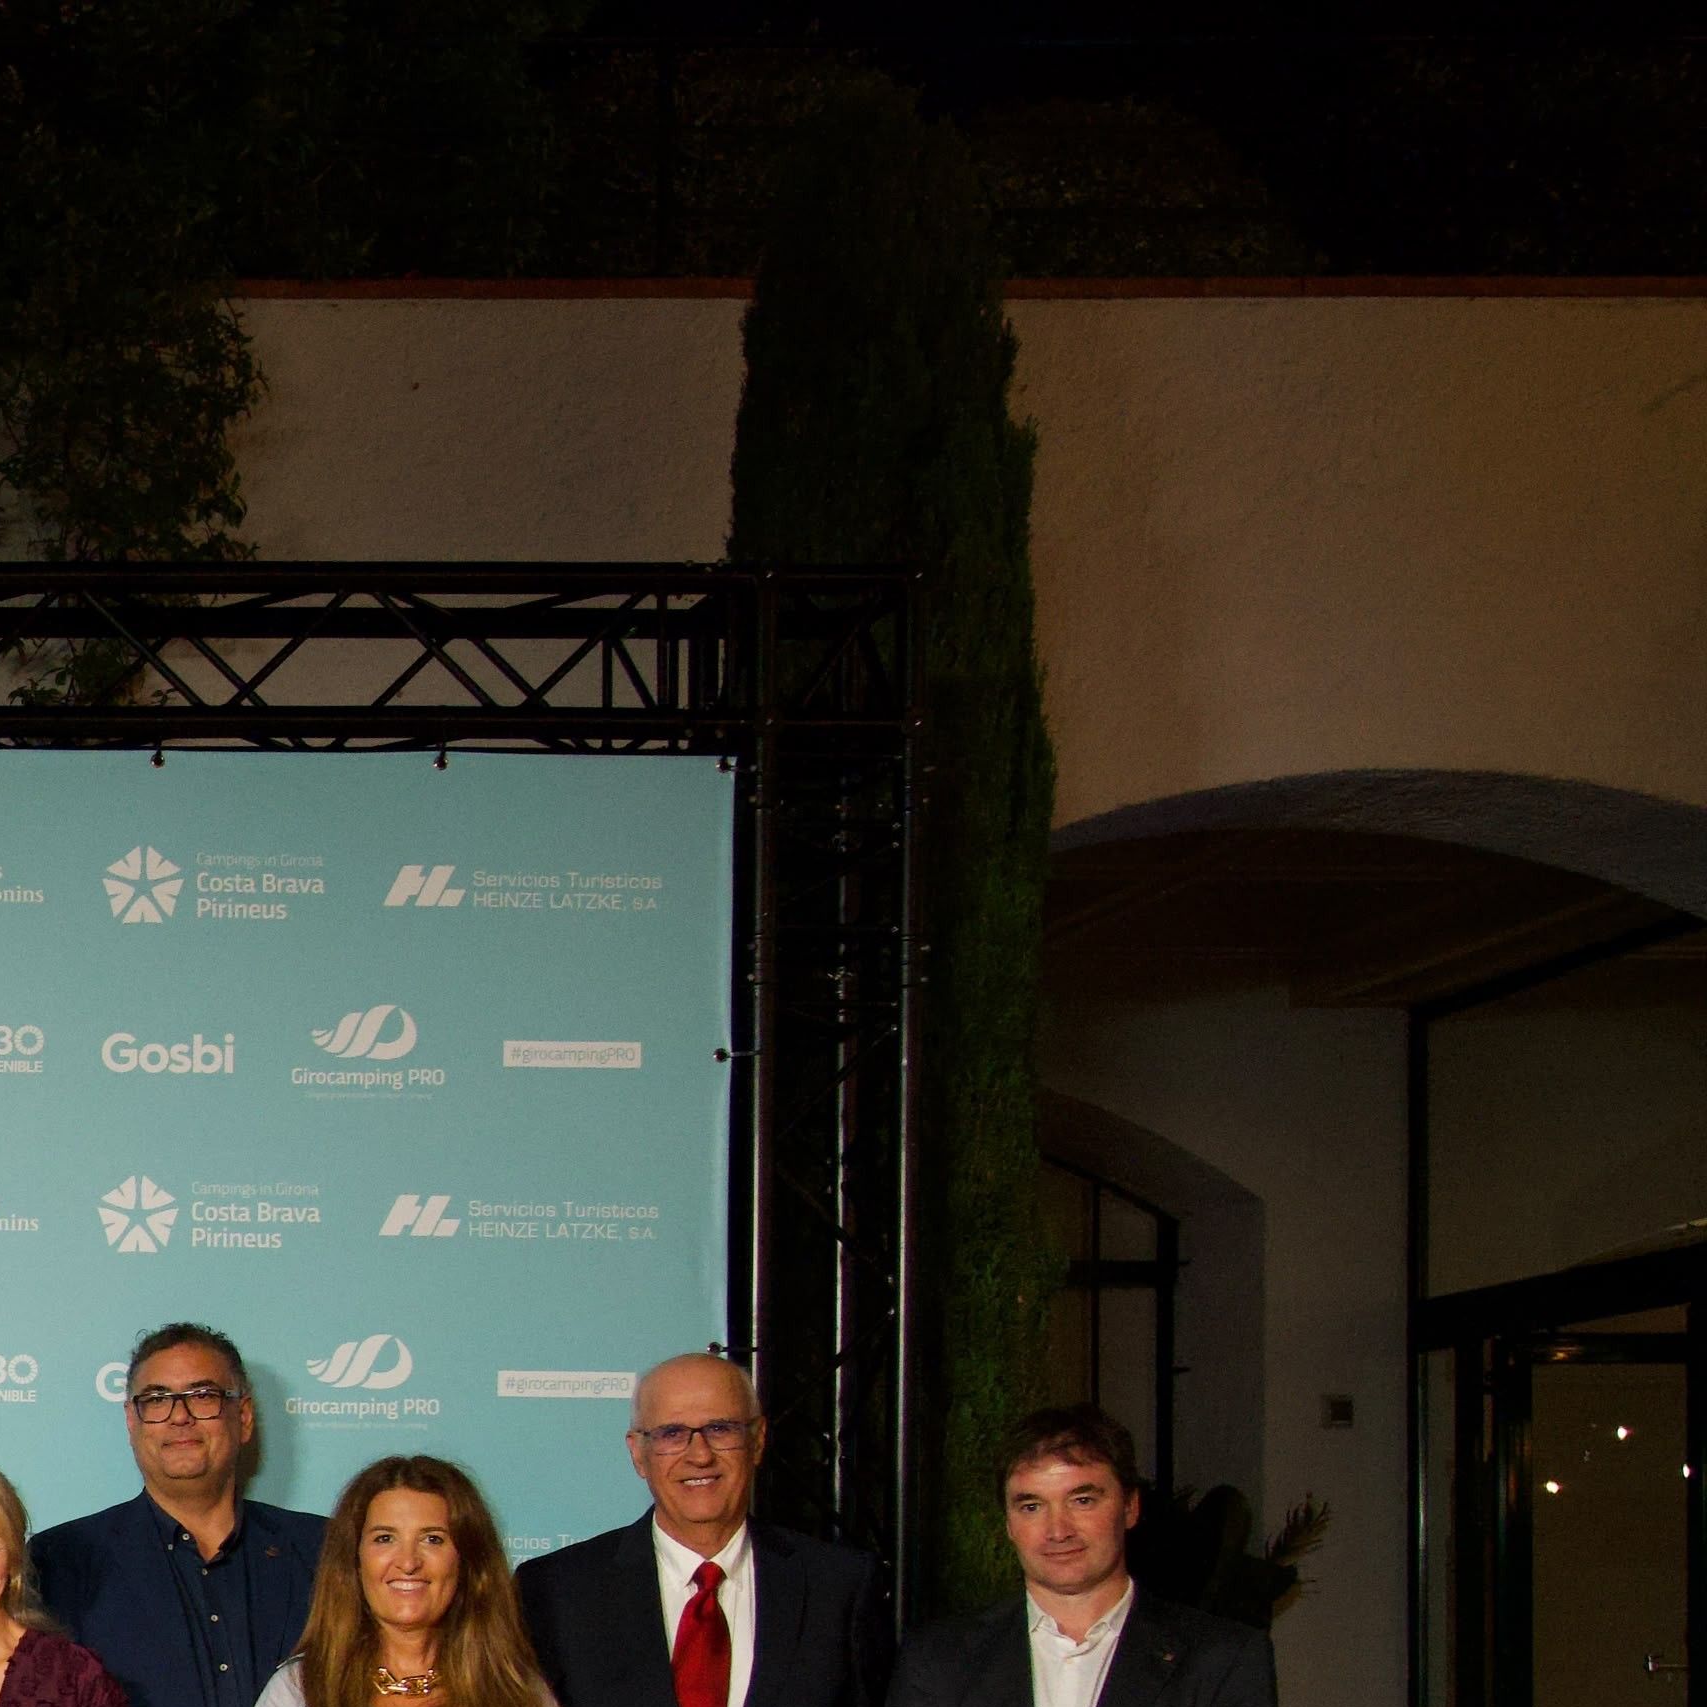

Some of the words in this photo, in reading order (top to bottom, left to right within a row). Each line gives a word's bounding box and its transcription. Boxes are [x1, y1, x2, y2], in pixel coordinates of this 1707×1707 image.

[196, 852, 262, 869] Campings
[264, 853, 277, 867] in
[280, 853, 323, 868] Girona
[196, 872, 256, 894] Costa
[262, 873, 325, 895] Brava
[473, 870, 560, 889] Servicios
[567, 871, 663, 890] Turísticos
[196, 898, 288, 920] Pirineus
[473, 892, 544, 910] HEINZE
[101, 1033, 236, 1074] Gosbi
[511, 1046, 636, 1065] #girocampingPRO
[291, 1067, 403, 1090] Girocamping
[408, 1069, 445, 1087] PRO
[191, 1181, 256, 1198] Campings
[259, 1182, 272, 1195] in
[275, 1182, 319, 1197] Girona
[191, 1202, 251, 1223] Costa
[257, 1203, 321, 1224] Brava
[468, 1200, 556, 1219] Servicios
[562, 1201, 659, 1220] Turísticos
[191, 1227, 282, 1249] Pirineus
[468, 1222, 539, 1240] HEINZE
[505, 1376, 630, 1394] #girocampingPRO
[285, 1398, 398, 1420] Girocamping
[404, 1399, 440, 1415] PRO
